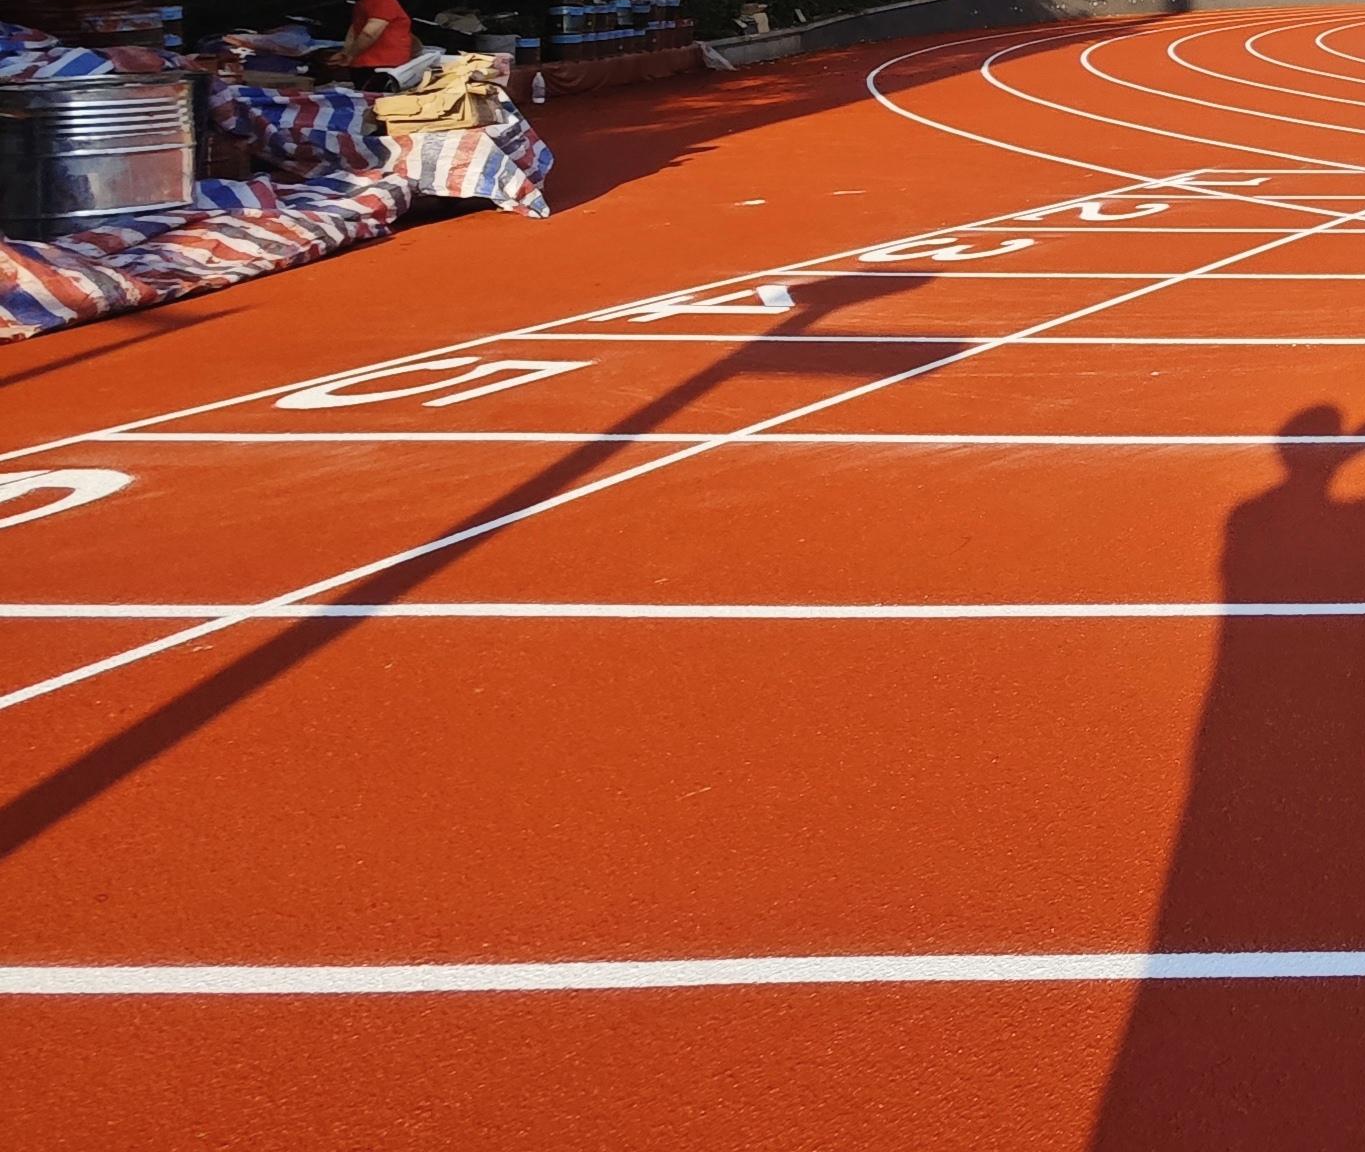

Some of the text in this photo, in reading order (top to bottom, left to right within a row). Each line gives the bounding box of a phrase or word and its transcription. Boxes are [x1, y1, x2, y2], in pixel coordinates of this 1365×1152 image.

[1013, 201, 1170, 221] 2
[858, 237, 1036, 262] 3
[586, 289, 791, 322] 4
[273, 356, 597, 409] 5
